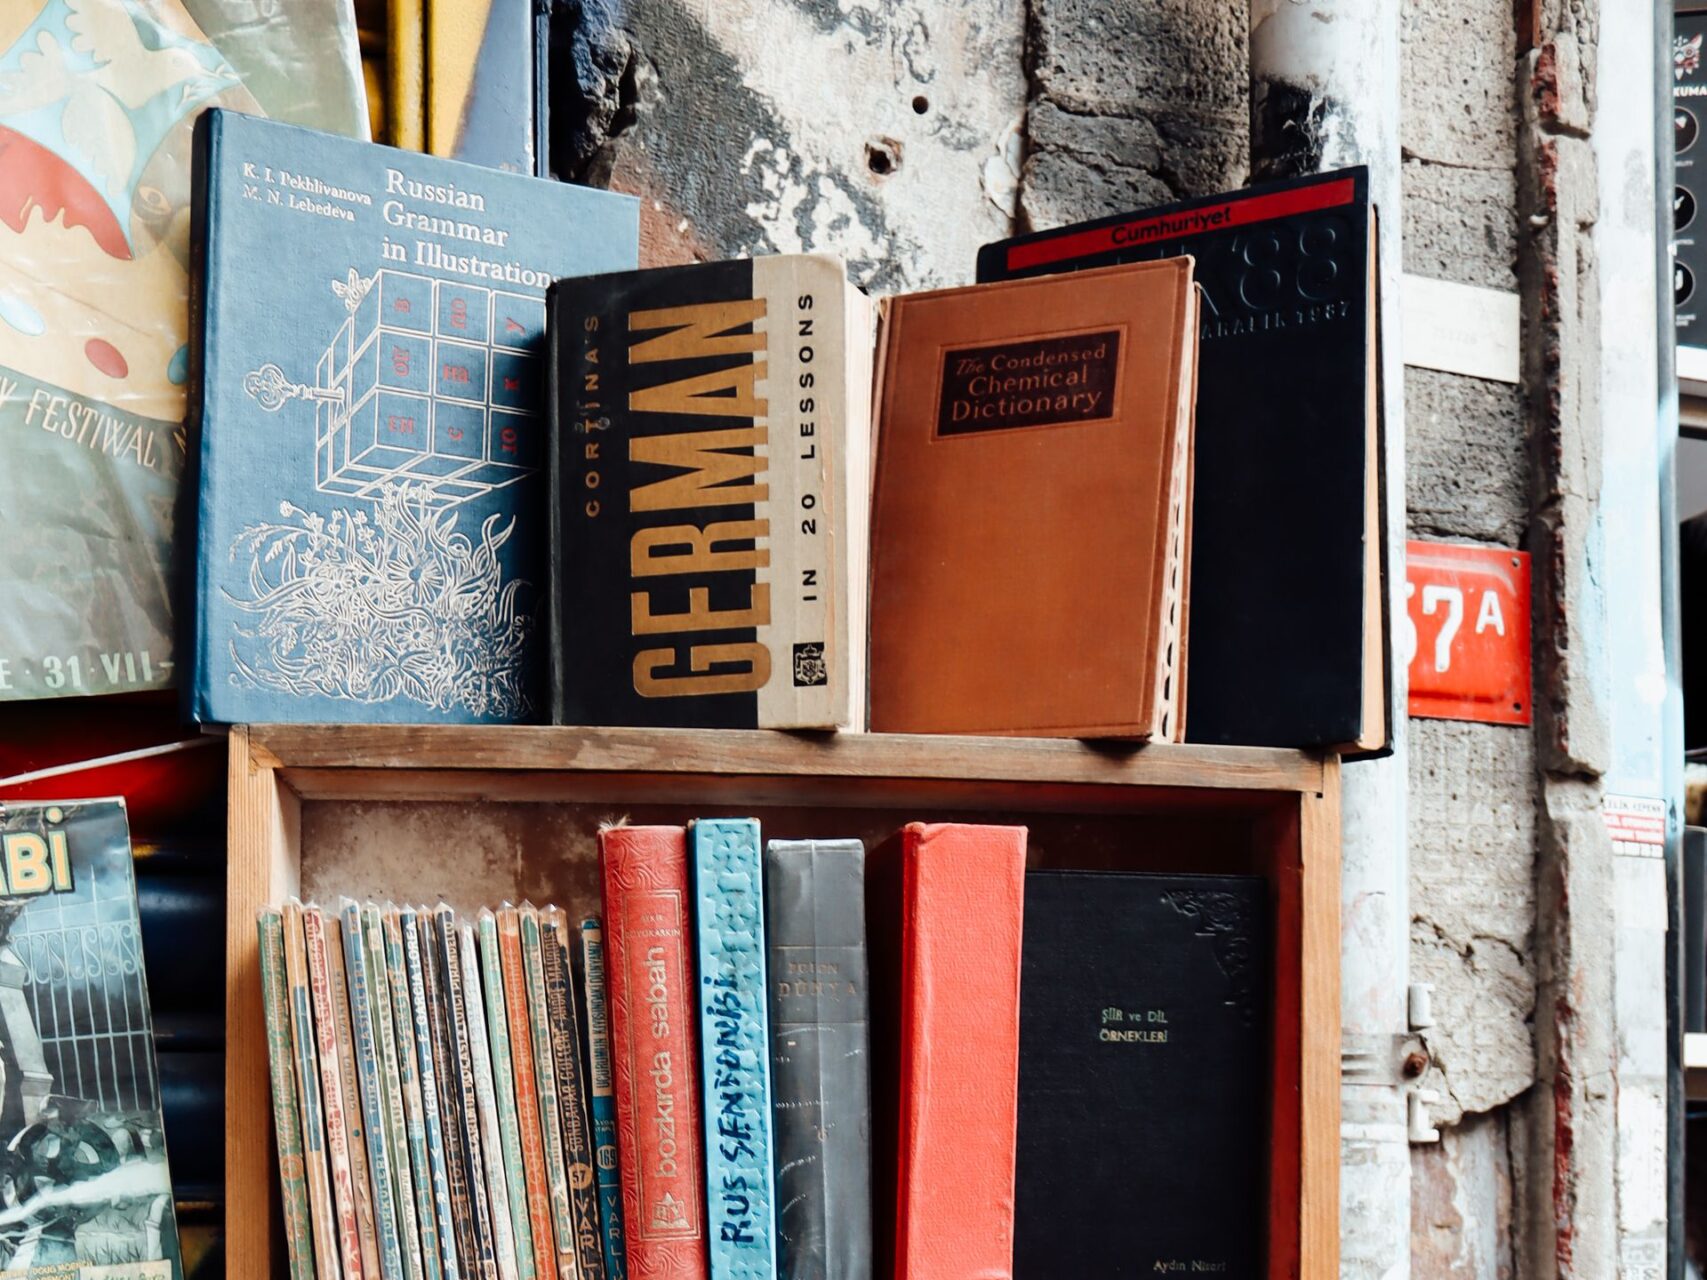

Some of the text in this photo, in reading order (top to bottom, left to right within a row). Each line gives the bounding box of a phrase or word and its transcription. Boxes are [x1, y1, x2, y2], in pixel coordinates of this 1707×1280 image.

[243, 162, 373, 207] K. I. Pekhlivanova
[243, 184, 356, 222] M. N. Lebedeva
[386, 168, 486, 212] Russian
[382, 199, 510, 248] Grammar
[1110, 205, 1233, 246] Cumhuriyet
[382, 237, 556, 289] in Illustration
[956, 343, 1107, 376] The Condensed
[968, 364, 1088, 397] Chemical
[25, 388, 157, 468] FESTIWAL
[585, 314, 600, 518] CORTINA'S
[952, 391, 1102, 422] Dictionary
[798, 293, 818, 602] IN 20 LESSONS
[628, 297, 772, 698] GERMAN
[1475, 590, 1506, 637] A
[43, 654, 83, 690] 31
[644, 945, 672, 1040] sabah
[1128, 1012, 1142, 1021] ve
[411, 973, 437, 1119] YERMA GARCIA
[650, 1050, 679, 1178] bozkırda
[571, 1168, 586, 1184] 57
[719, 1175, 755, 1243] RUS
